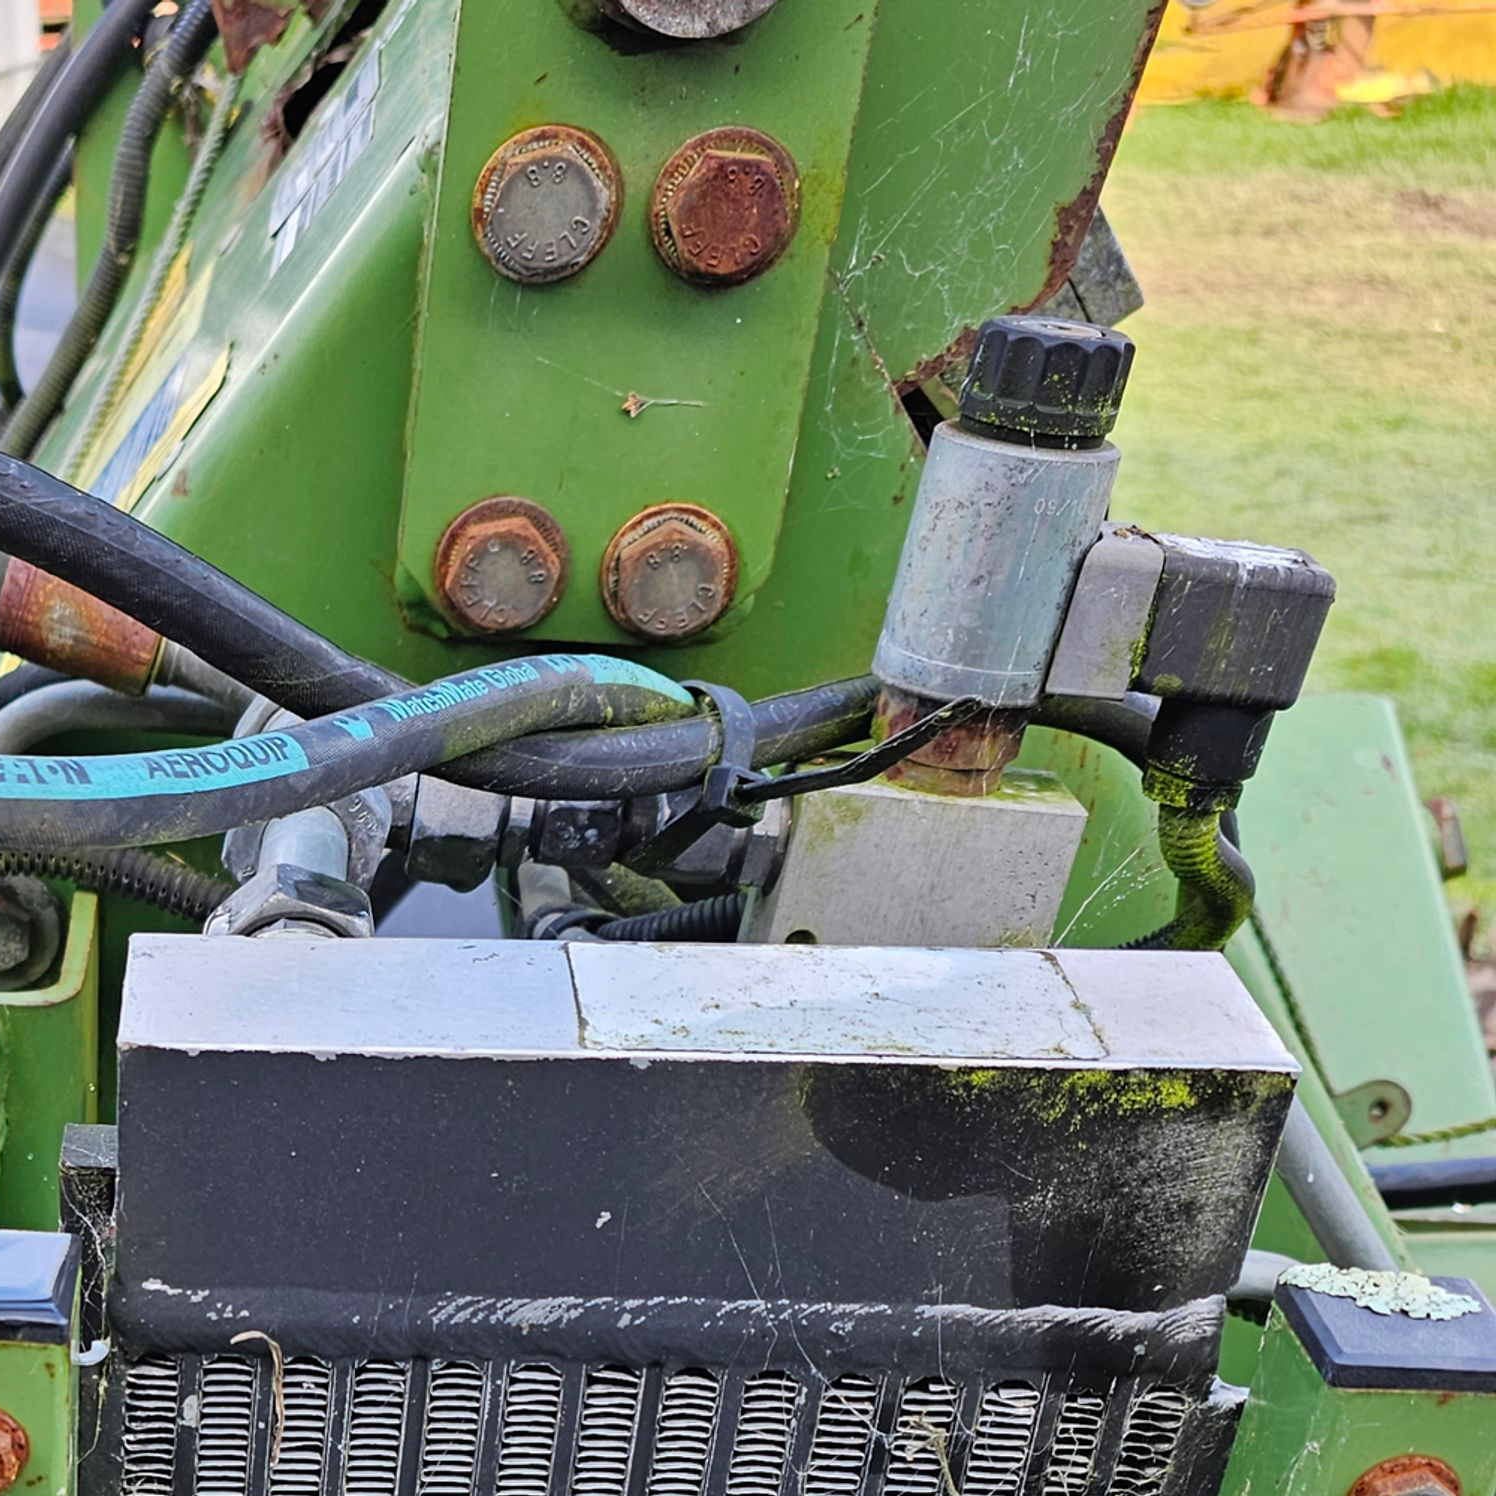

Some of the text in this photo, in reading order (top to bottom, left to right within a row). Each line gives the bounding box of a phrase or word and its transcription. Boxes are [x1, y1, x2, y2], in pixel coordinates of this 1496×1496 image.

[375, 681, 489, 723] MatchMate
[477, 662, 541, 690] Global
[146, 735, 291, 780] AEROQUIP
